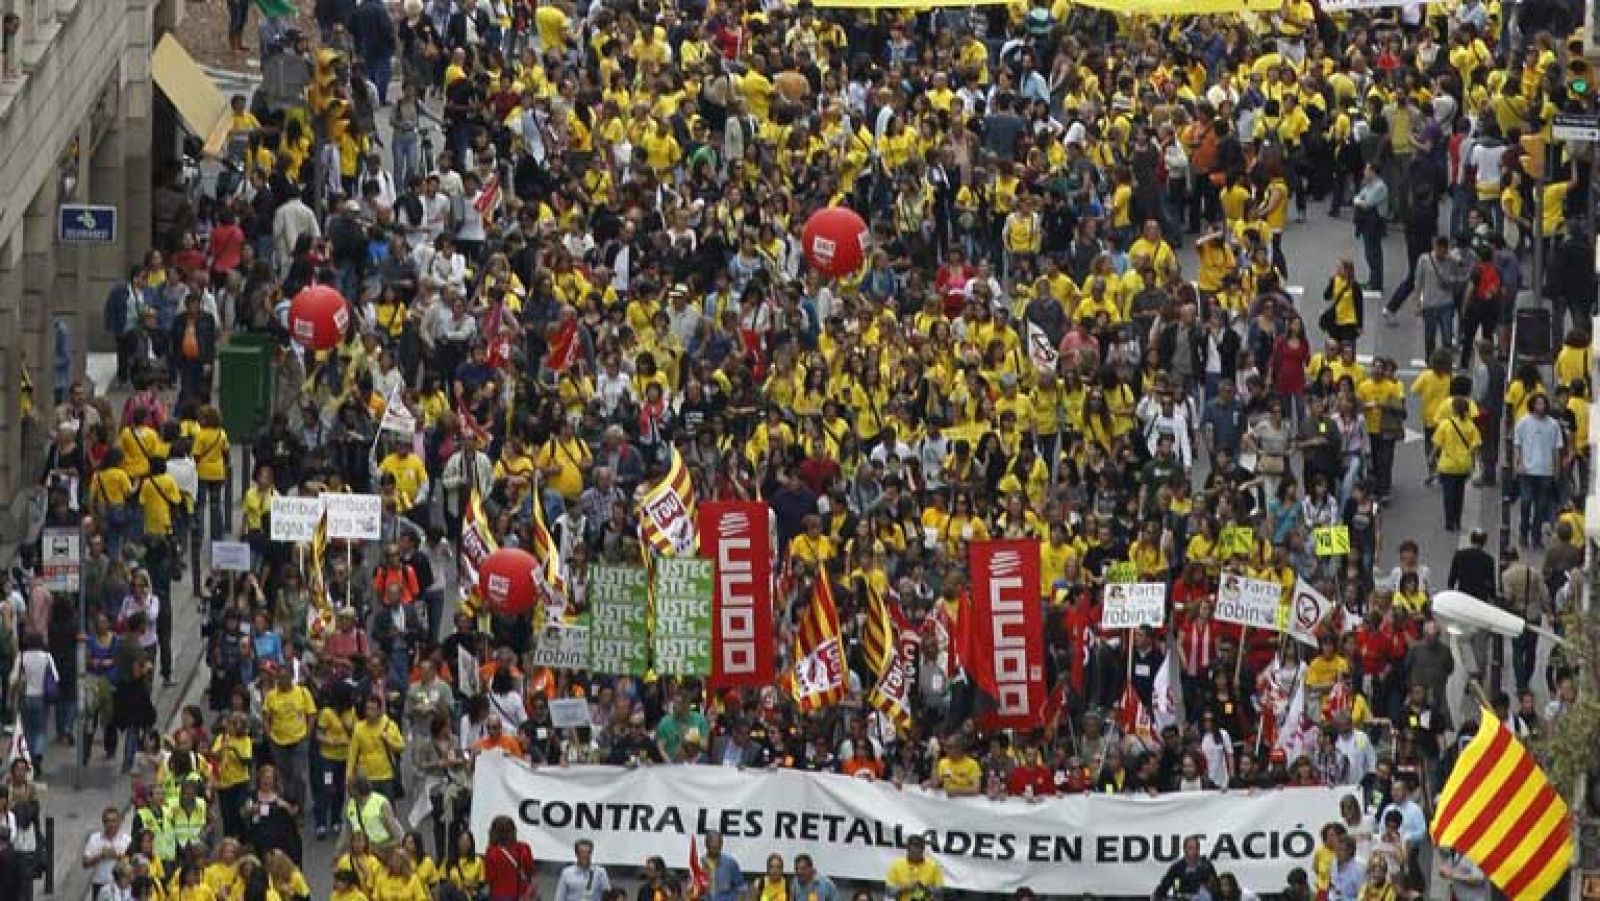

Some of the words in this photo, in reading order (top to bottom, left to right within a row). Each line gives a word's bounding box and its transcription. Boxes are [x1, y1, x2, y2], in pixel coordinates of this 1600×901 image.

[272, 498, 319, 516] Retribuc
[594, 566, 646, 586] USTEC
[658, 558, 711, 579] USTEC
[658, 578, 697, 595] STEs
[592, 602, 645, 622] USTEC
[657, 598, 710, 618] USTEC
[719, 538, 755, 673] CCOO
[1105, 607, 1146, 624] robin
[1218, 601, 1259, 621] robin
[656, 617, 695, 635] STEs
[593, 639, 645, 659] USTEC
[656, 638, 709, 657] USTEC
[990, 577, 1029, 716] CCOO
[537, 650, 580, 664] robin
[656, 656, 694, 673] STEs
[518, 799, 685, 834] CONTRA
[697, 808, 763, 836] LES
[774, 811, 1016, 860] RETALLADES
[1028, 835, 1082, 862] EN
